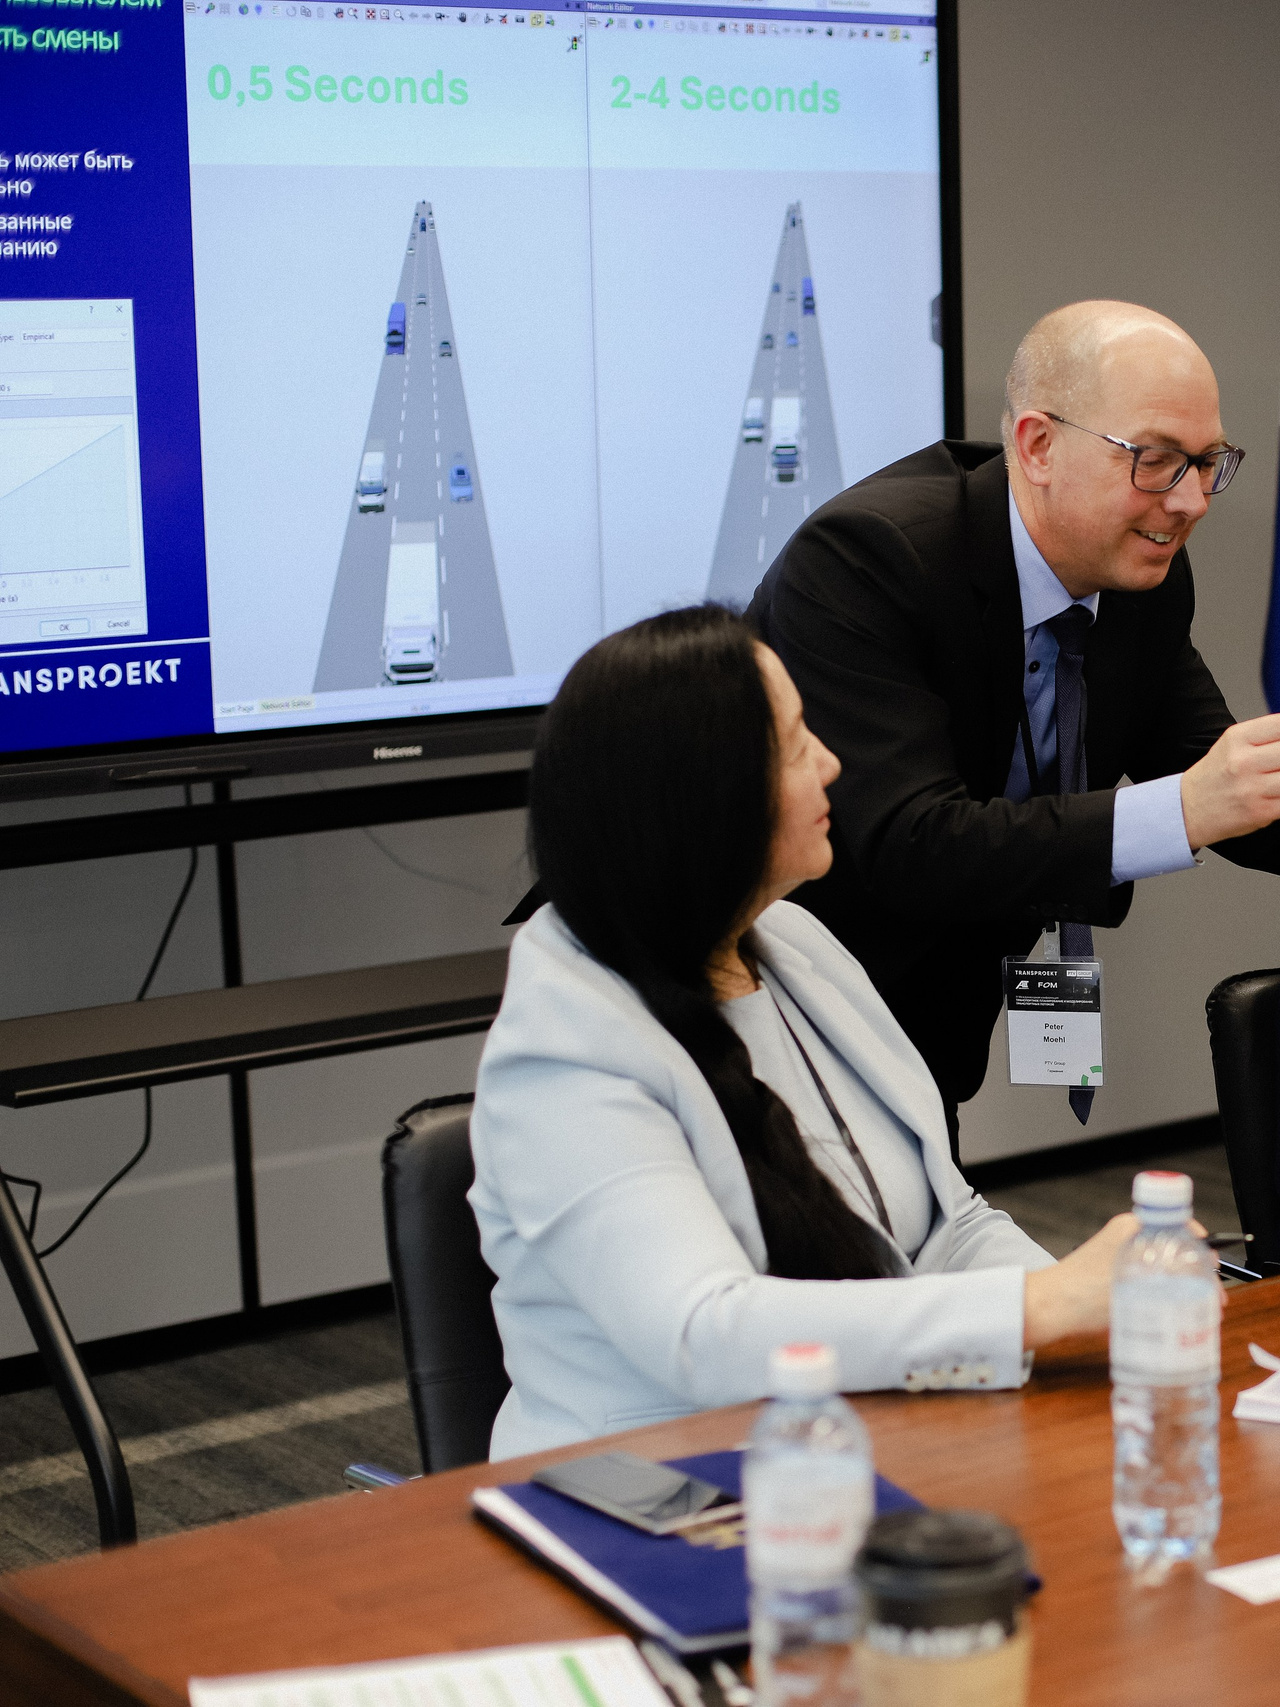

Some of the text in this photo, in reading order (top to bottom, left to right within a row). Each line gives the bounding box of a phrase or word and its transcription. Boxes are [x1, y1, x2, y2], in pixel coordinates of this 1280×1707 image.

[32, 29, 119, 50] смены
[207, 64, 469, 107] 0,5 Seconds
[610, 75, 841, 114] 2-4 Seconds
[15, 154, 79, 168] может
[84, 151, 133, 169] быть
[0, 241, 58, 255] анию
[373, 746, 422, 760] Hisense
